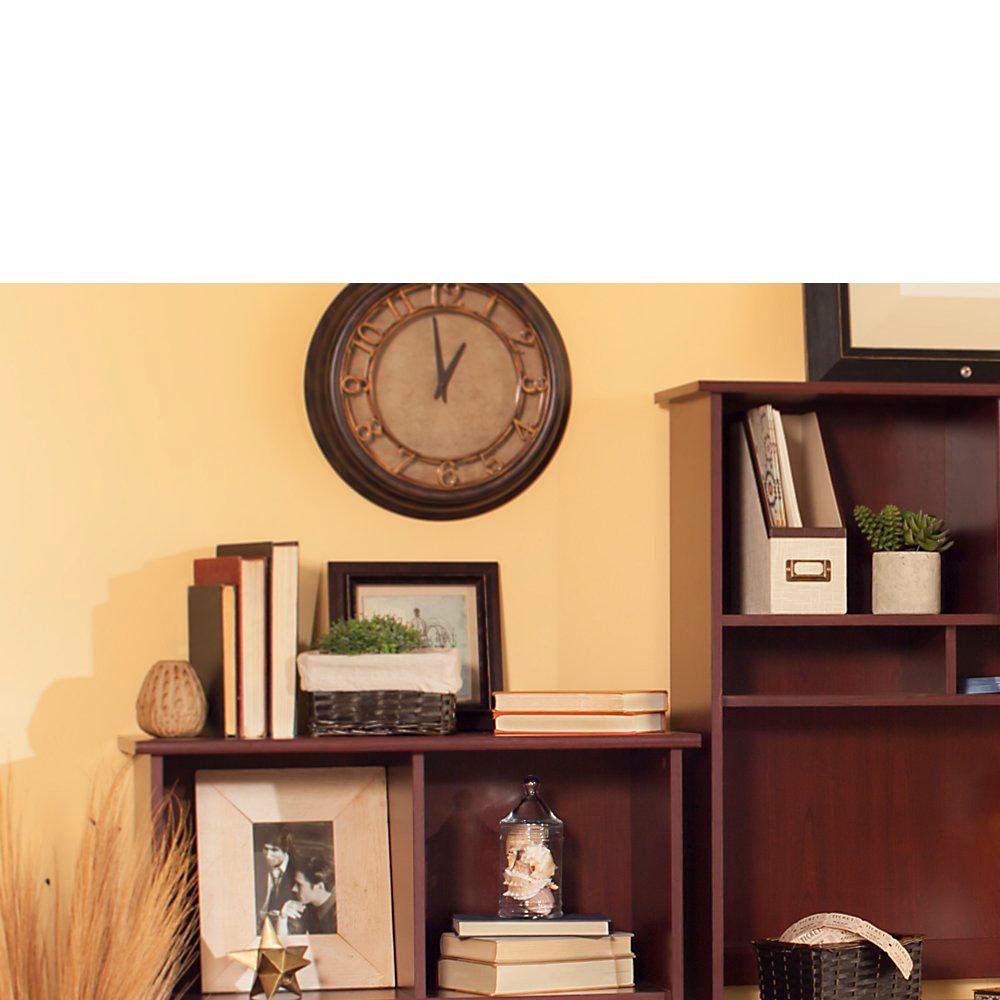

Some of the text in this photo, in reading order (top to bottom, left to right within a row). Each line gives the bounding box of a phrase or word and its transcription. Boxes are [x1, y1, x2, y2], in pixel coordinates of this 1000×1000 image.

[386, 290, 416, 321] 11
[430, 284, 465, 306] 12
[353, 323, 384, 354] 10
[508, 327, 537, 352] 2
[341, 376, 371, 393] 9
[520, 376, 547, 394] 3
[356, 418, 382, 442] 8
[512, 418, 538, 442] 4
[437, 460, 459, 488] 6
[801, 927, 824, 943] TICKET
